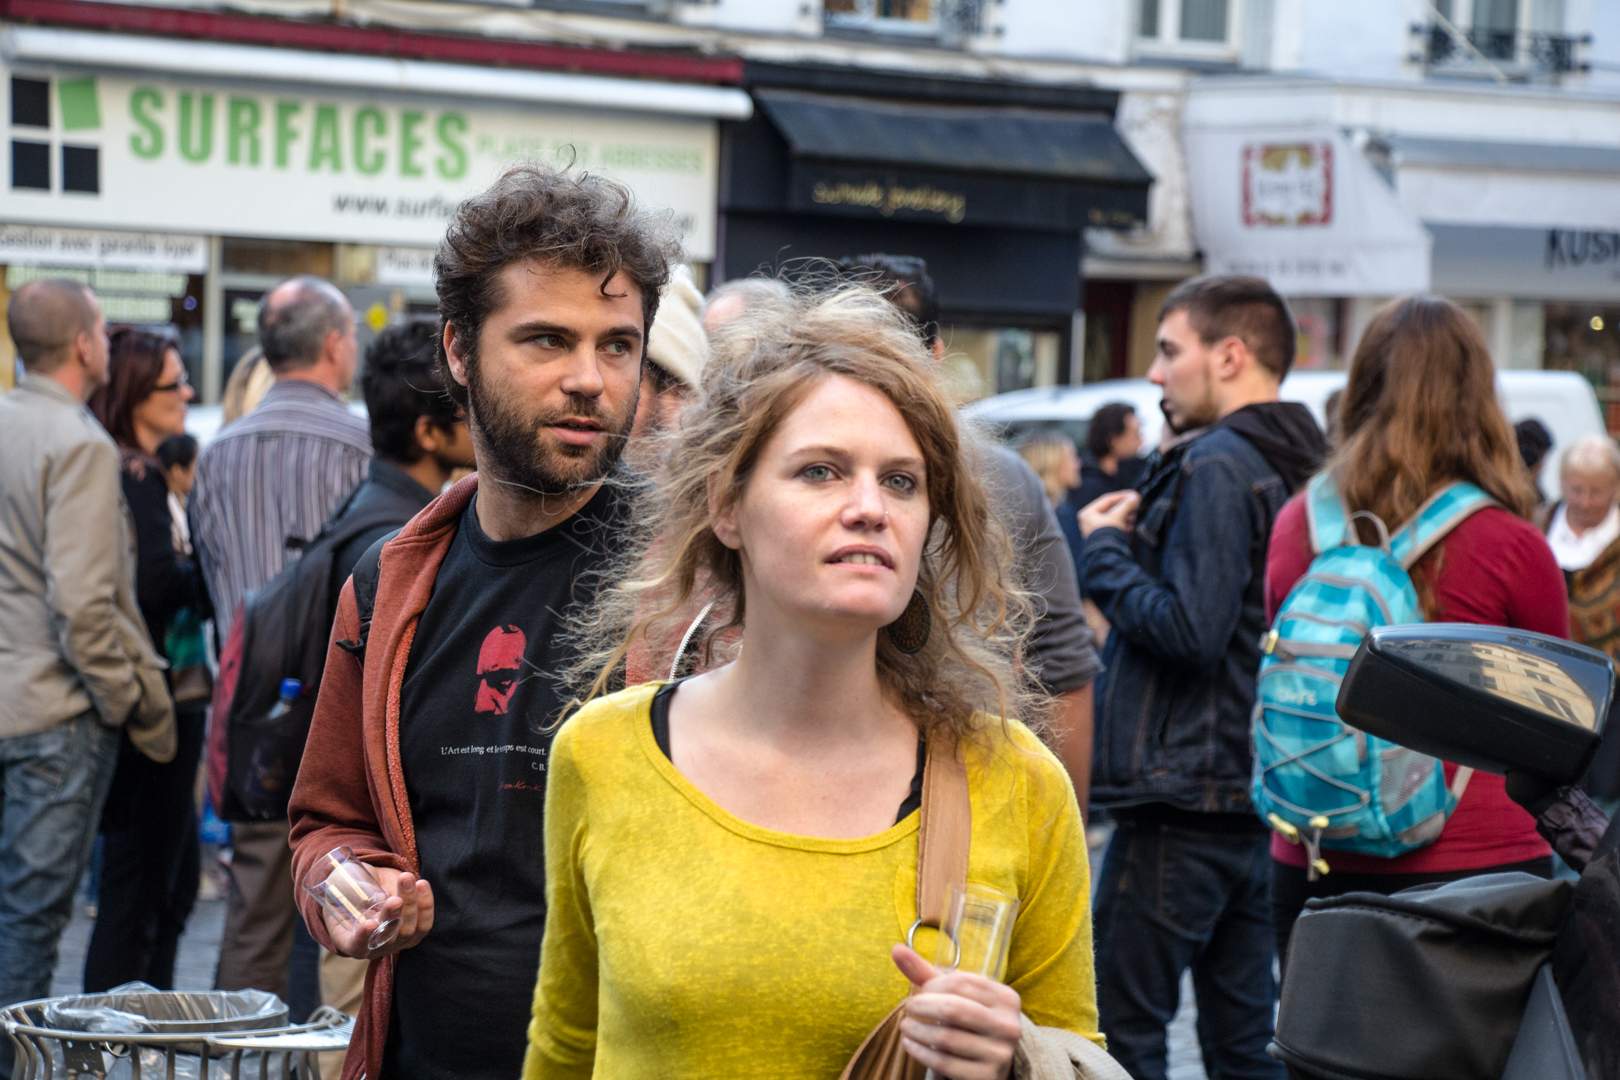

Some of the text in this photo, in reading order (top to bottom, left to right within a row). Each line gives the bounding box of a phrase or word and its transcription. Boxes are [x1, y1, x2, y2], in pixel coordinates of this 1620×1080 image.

[129, 86, 470, 180] SURFACES
[332, 194, 456, 219] www.surfa
[441, 746, 460, 756] L'Art
[460, 745, 470, 754] est
[470, 744, 485, 756] long
[486, 745, 494, 754] et
[515, 744, 527, 753] est
